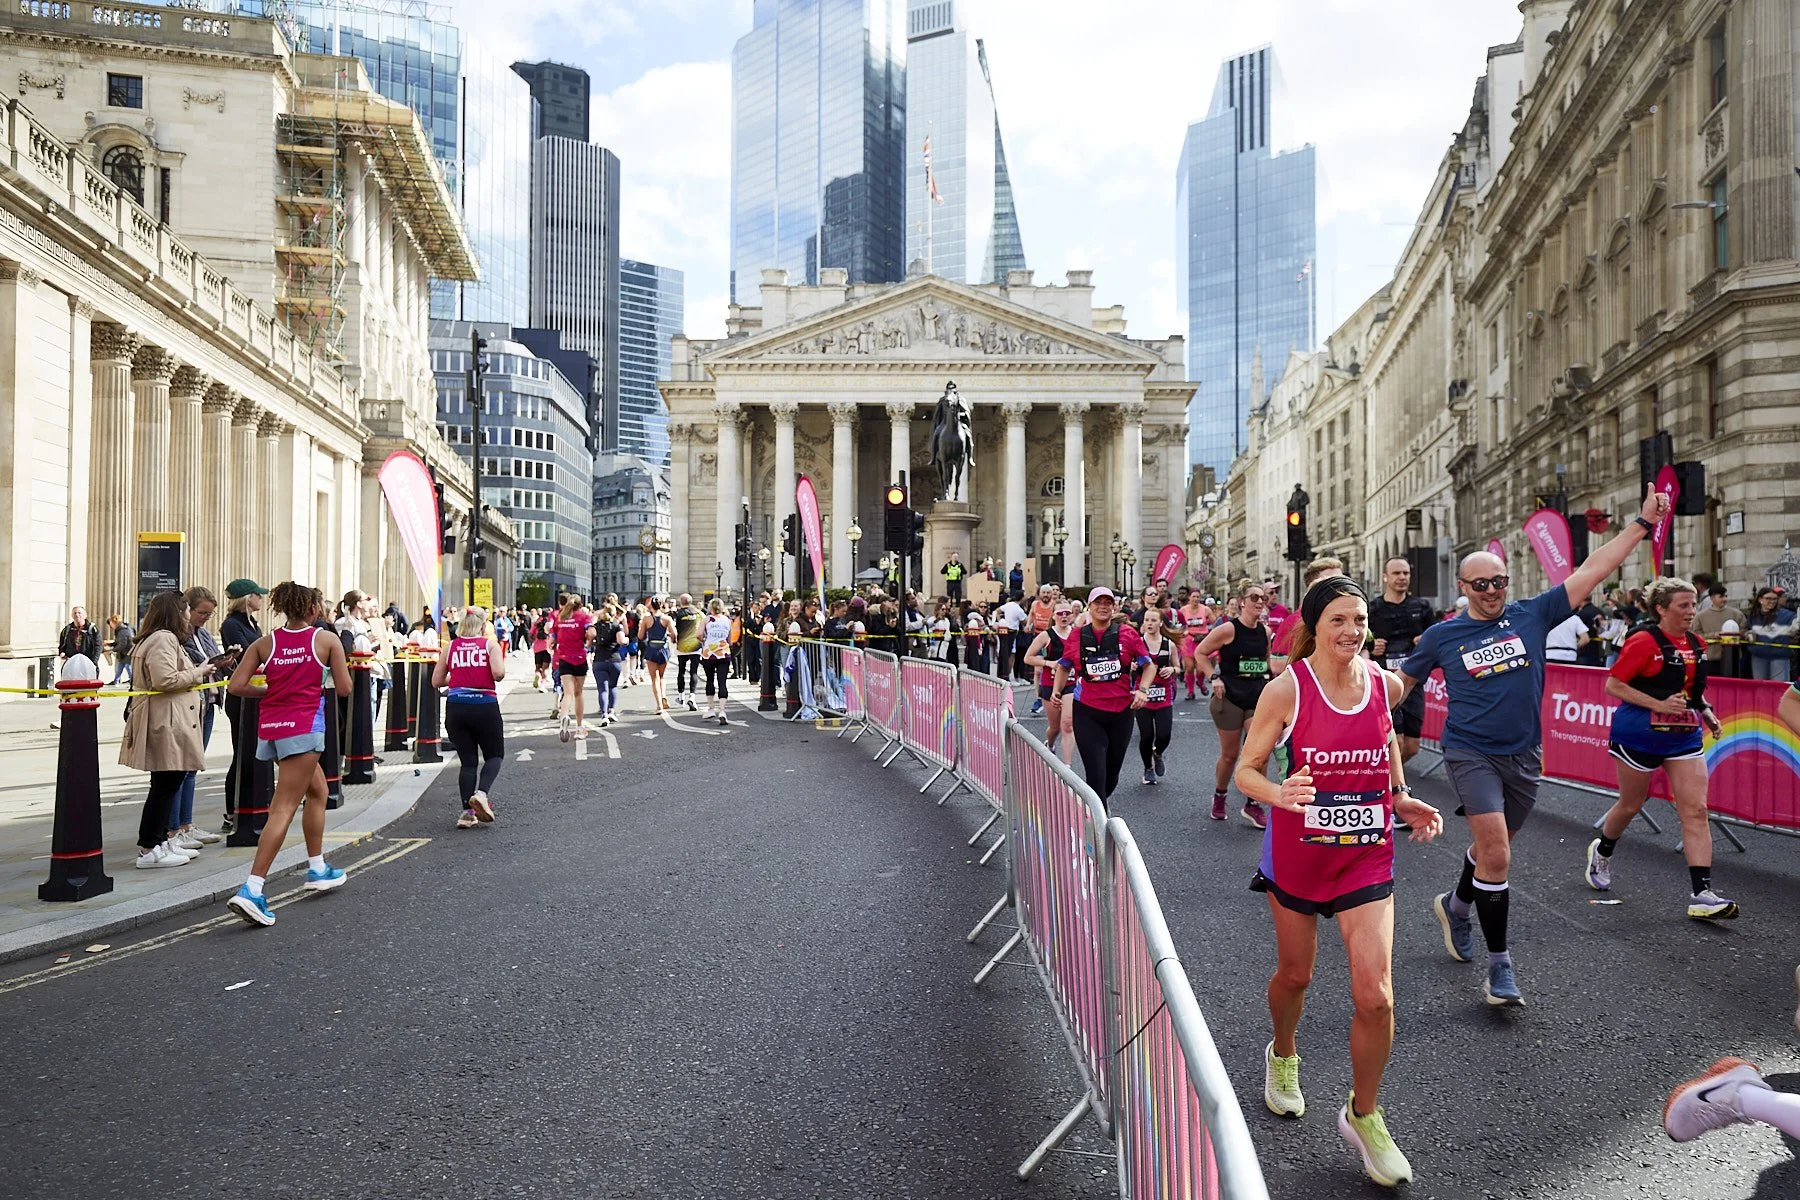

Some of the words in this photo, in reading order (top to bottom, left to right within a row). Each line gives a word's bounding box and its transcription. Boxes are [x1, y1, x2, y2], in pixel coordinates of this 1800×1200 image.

[1481, 637, 1494, 645] IZZY
[281, 646, 306, 656] Team
[1472, 643, 1515, 664] 9896
[272, 654, 312, 665] Tommy's
[451, 649, 487, 669] ALICE
[1091, 662, 1117, 673] 9686
[1301, 743, 1390, 767] Tommy's
[1333, 794, 1362, 802] CHELLE
[1317, 807, 1374, 828] 9893
